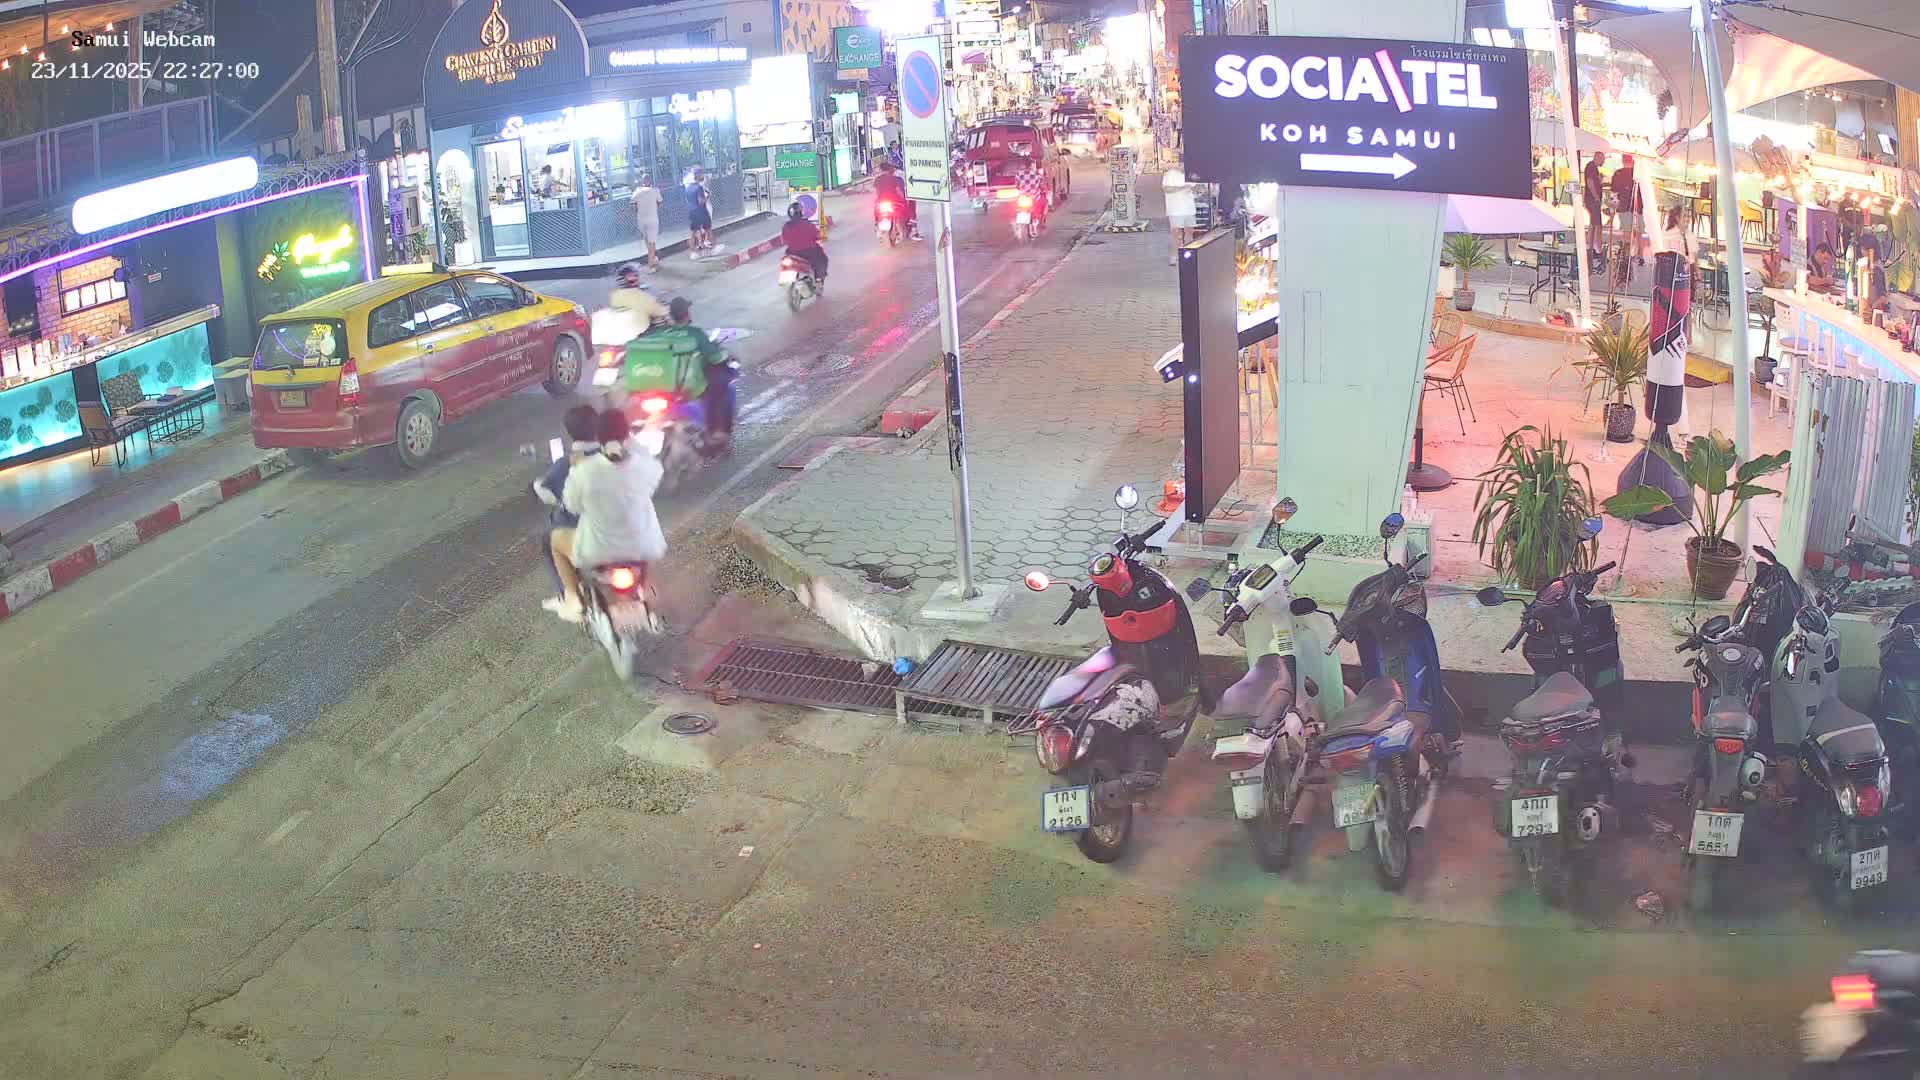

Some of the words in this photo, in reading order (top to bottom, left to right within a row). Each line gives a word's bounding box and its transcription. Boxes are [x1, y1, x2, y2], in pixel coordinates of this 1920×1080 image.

[839, 52, 880, 64] EXCHANGE
[1260, 123, 1328, 144] KOH
[1347, 125, 1456, 150] SAMUI
[776, 159, 814, 169] EXCHANGE
[910, 159, 918, 168] NO
[918, 159, 942, 168] PARKING
